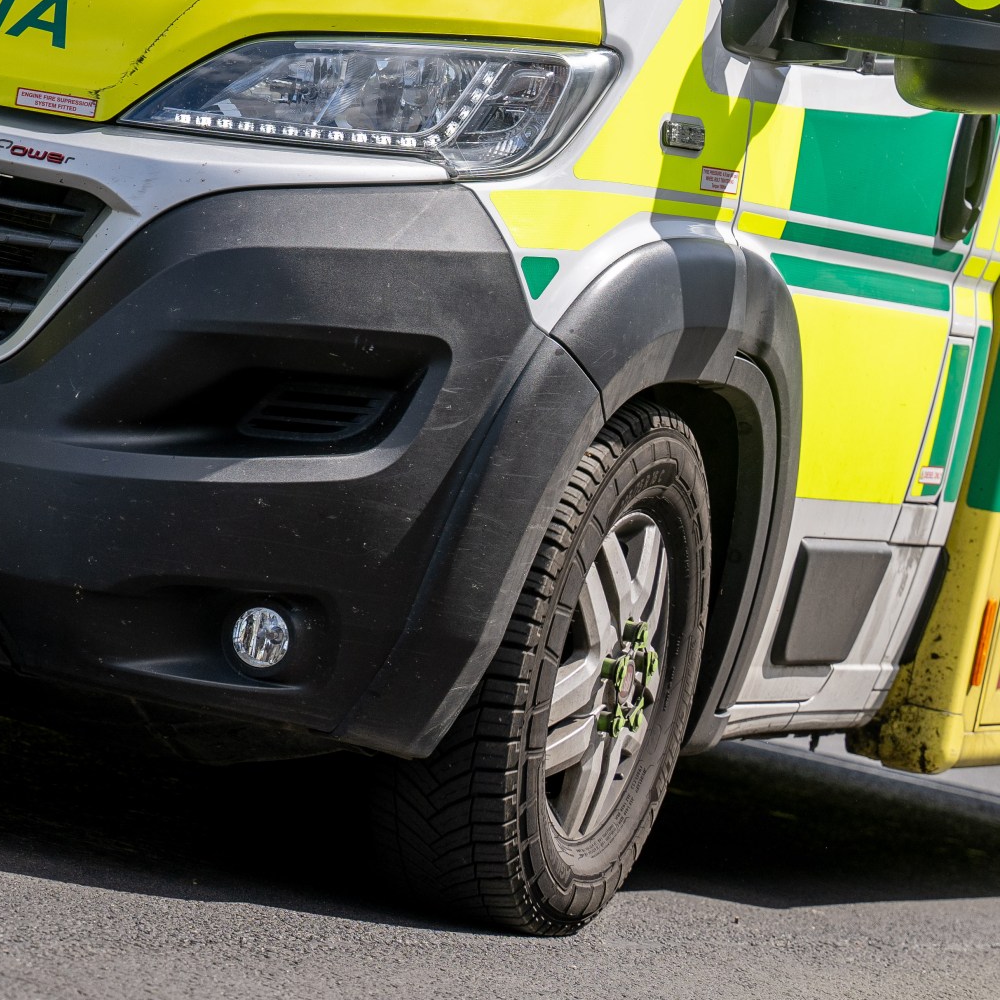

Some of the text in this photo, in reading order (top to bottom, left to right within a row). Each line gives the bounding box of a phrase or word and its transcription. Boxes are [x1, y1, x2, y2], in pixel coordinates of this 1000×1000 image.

[21, 91, 93, 107] ENGINE FIRE SUPRESSION
[34, 100, 77, 112] SYSTEM FITTED
